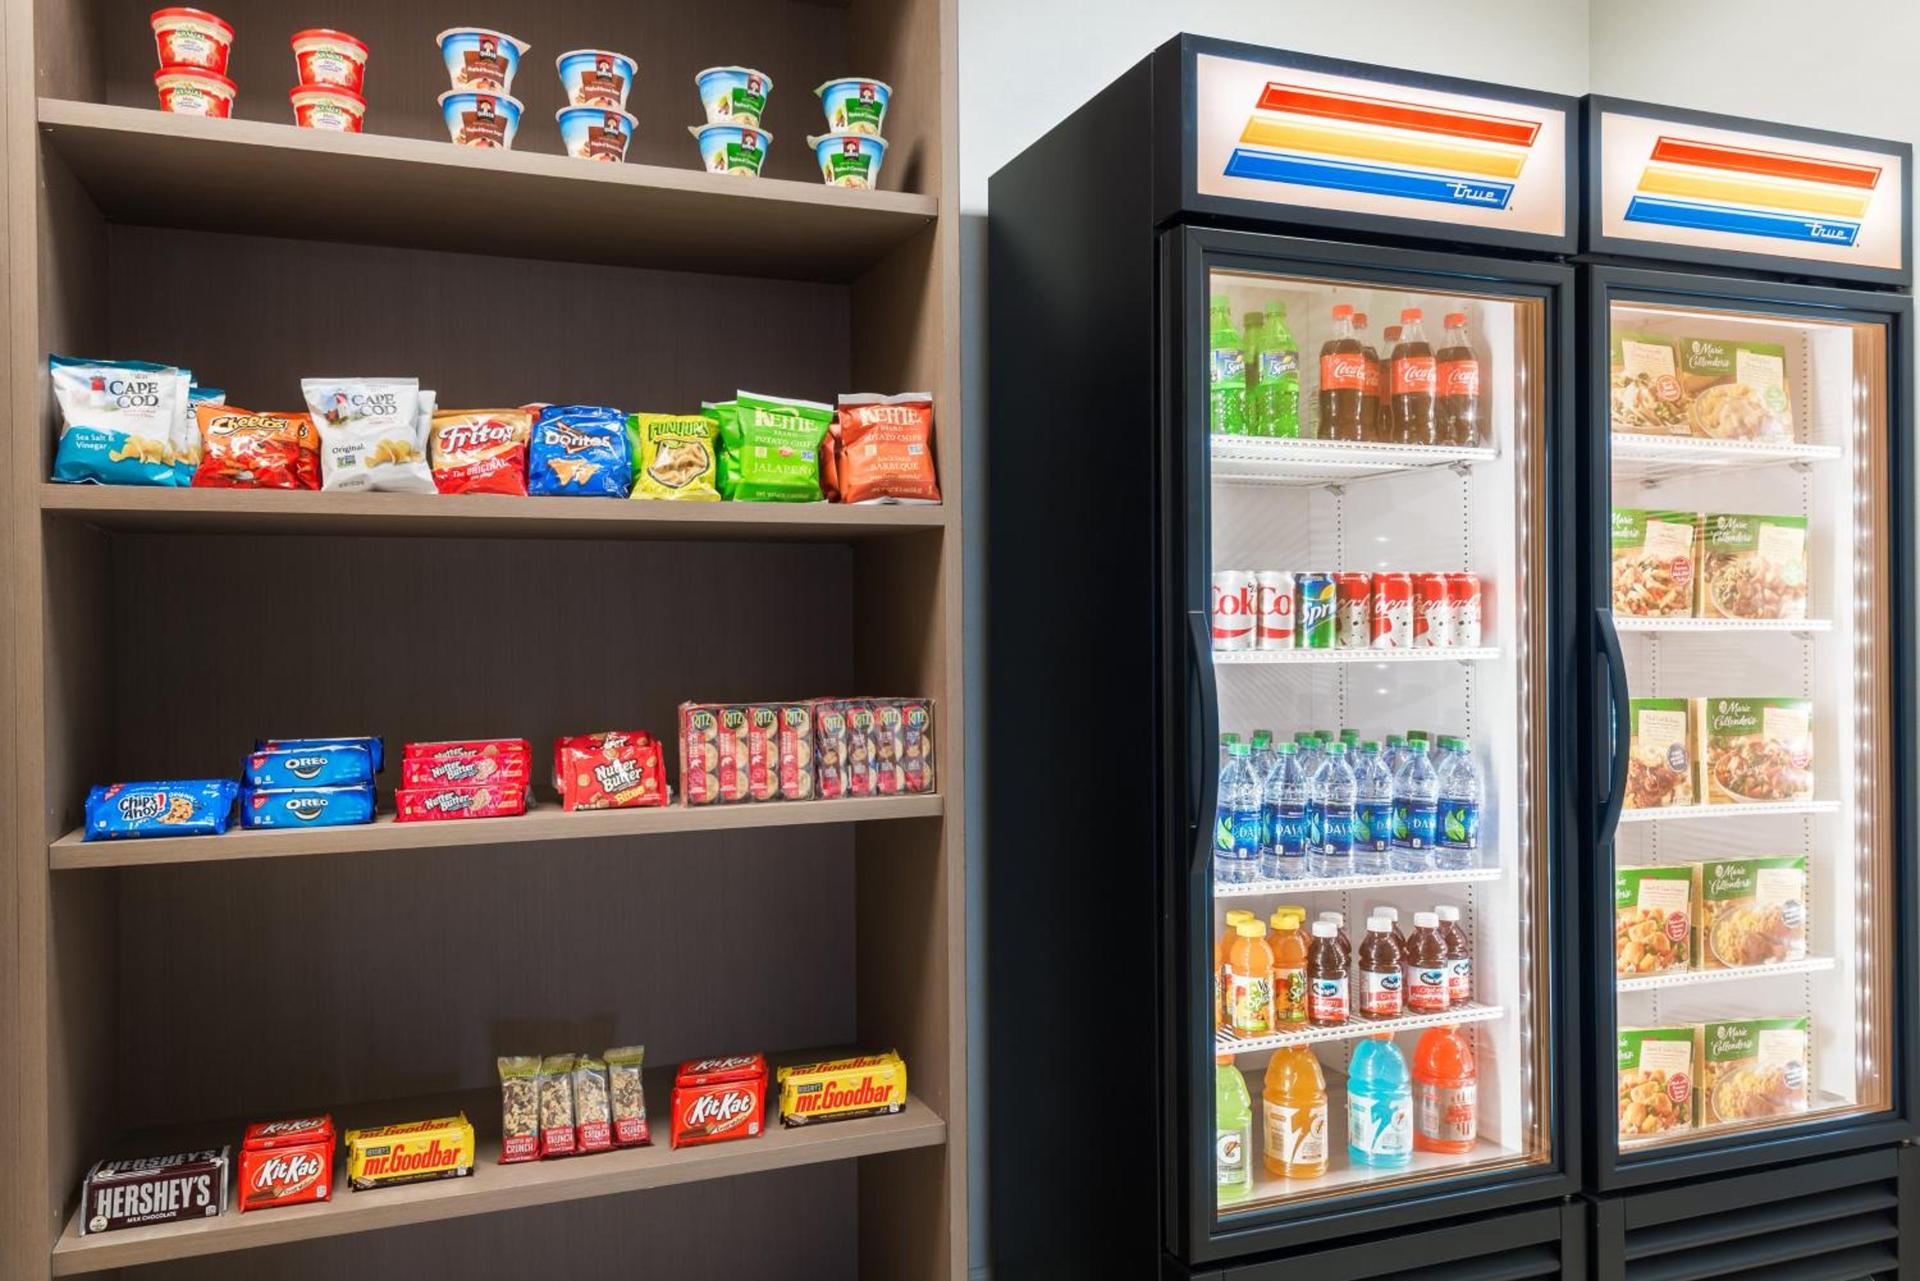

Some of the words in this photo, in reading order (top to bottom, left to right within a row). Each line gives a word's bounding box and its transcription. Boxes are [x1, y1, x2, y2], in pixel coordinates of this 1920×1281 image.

[110, 381, 159, 395] CAPE
[117, 394, 160, 408] COD
[351, 393, 396, 406] CAPE
[358, 404, 398, 416] COD
[859, 406, 922, 426] KETTLE
[438, 423, 514, 454] Fritos
[545, 424, 611, 447] Doritos
[76, 442, 107, 451] Vinegar
[285, 757, 328, 769] OREO
[431, 760, 463, 778] Nutter
[594, 759, 637, 782] Nutter
[603, 768, 643, 793] Butter
[119, 794, 157, 812] Chips
[286, 799, 328, 810] OREO
[425, 792, 458, 811] Nutter
[689, 1092, 753, 1125] KitKat
[506, 1144, 535, 1154] CRUNCH
[256, 1155, 321, 1189] KitKat
[97, 1174, 212, 1220] HERSHEY'S
[142, 1211, 178, 1222] CHOCOLATE
